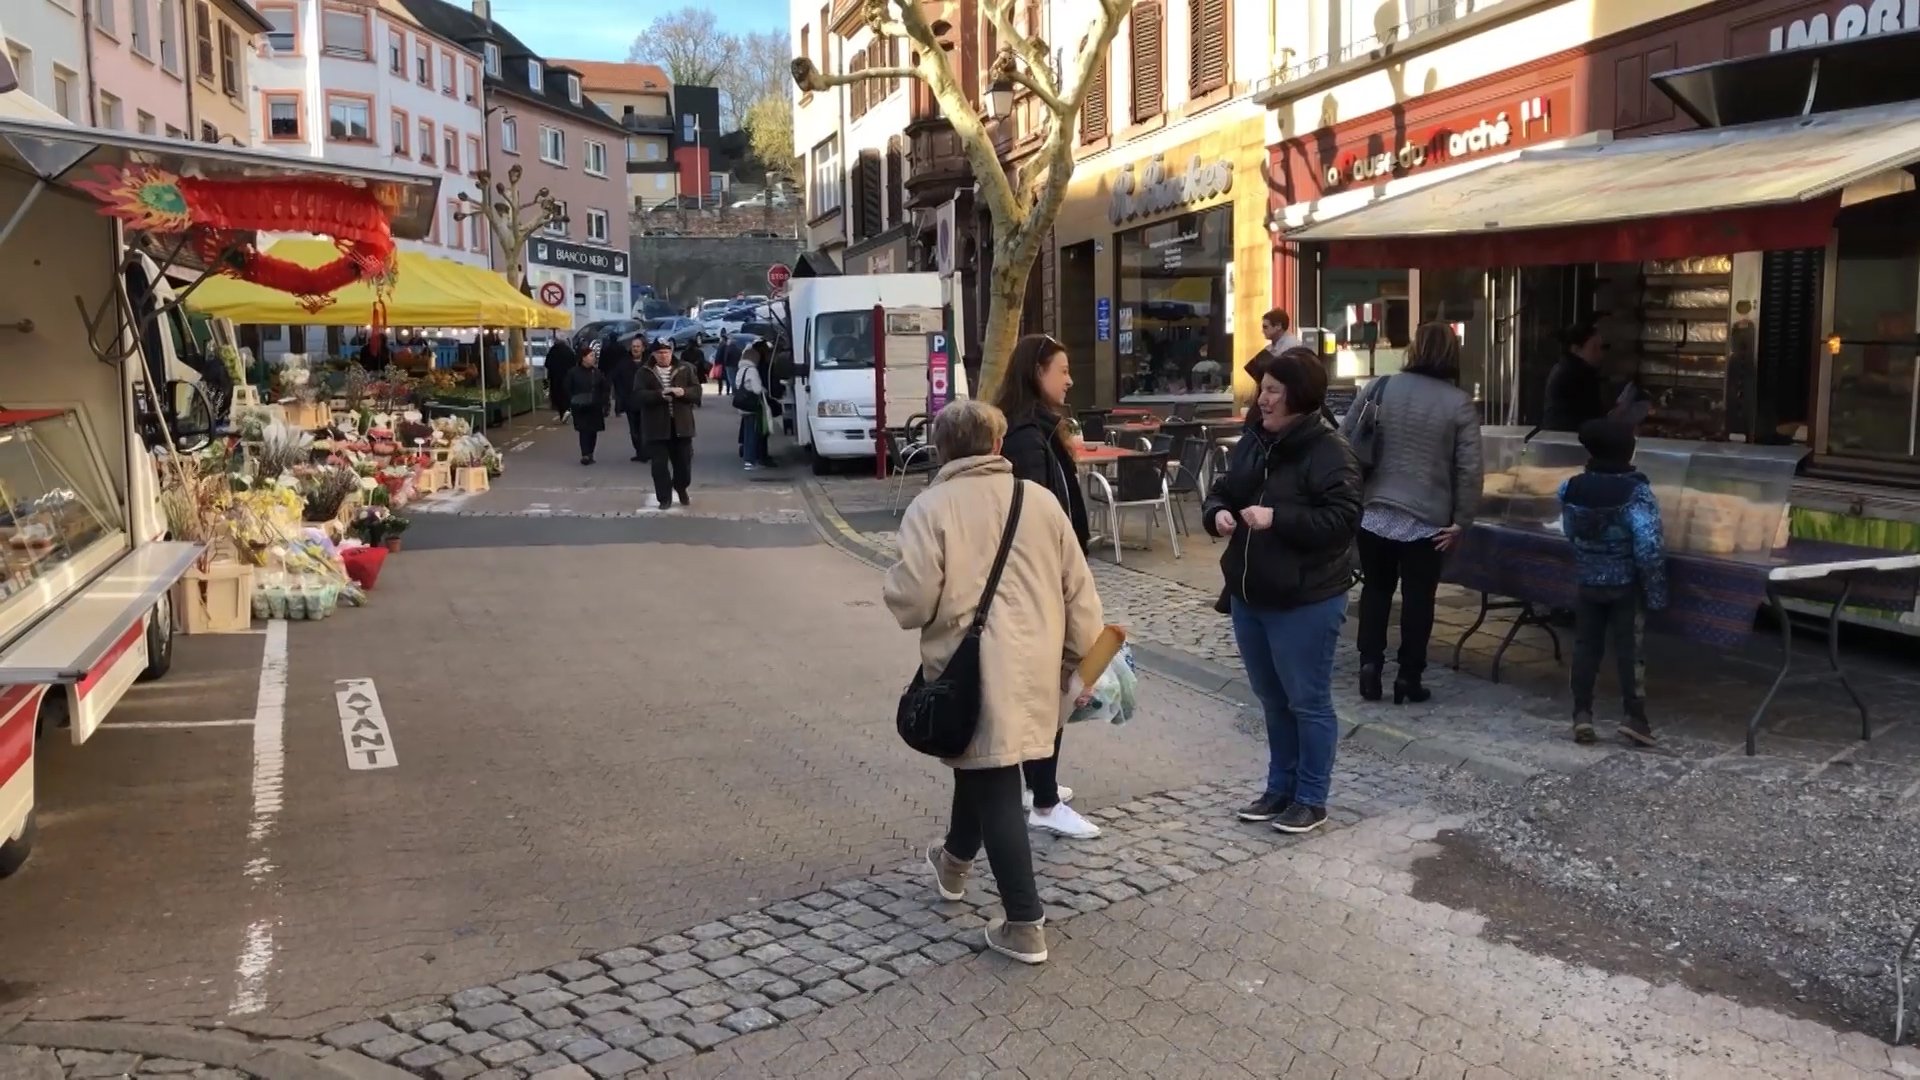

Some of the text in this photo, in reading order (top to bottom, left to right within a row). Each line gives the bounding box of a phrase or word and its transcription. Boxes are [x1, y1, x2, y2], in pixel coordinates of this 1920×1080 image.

[1770, 0, 1919, 51] IMPRI
[1399, 140, 1425, 167] du
[556, 249, 609, 268] BIANCO NERO
[934, 335, 945, 352] P
[334, 679, 386, 765] PAYANT
